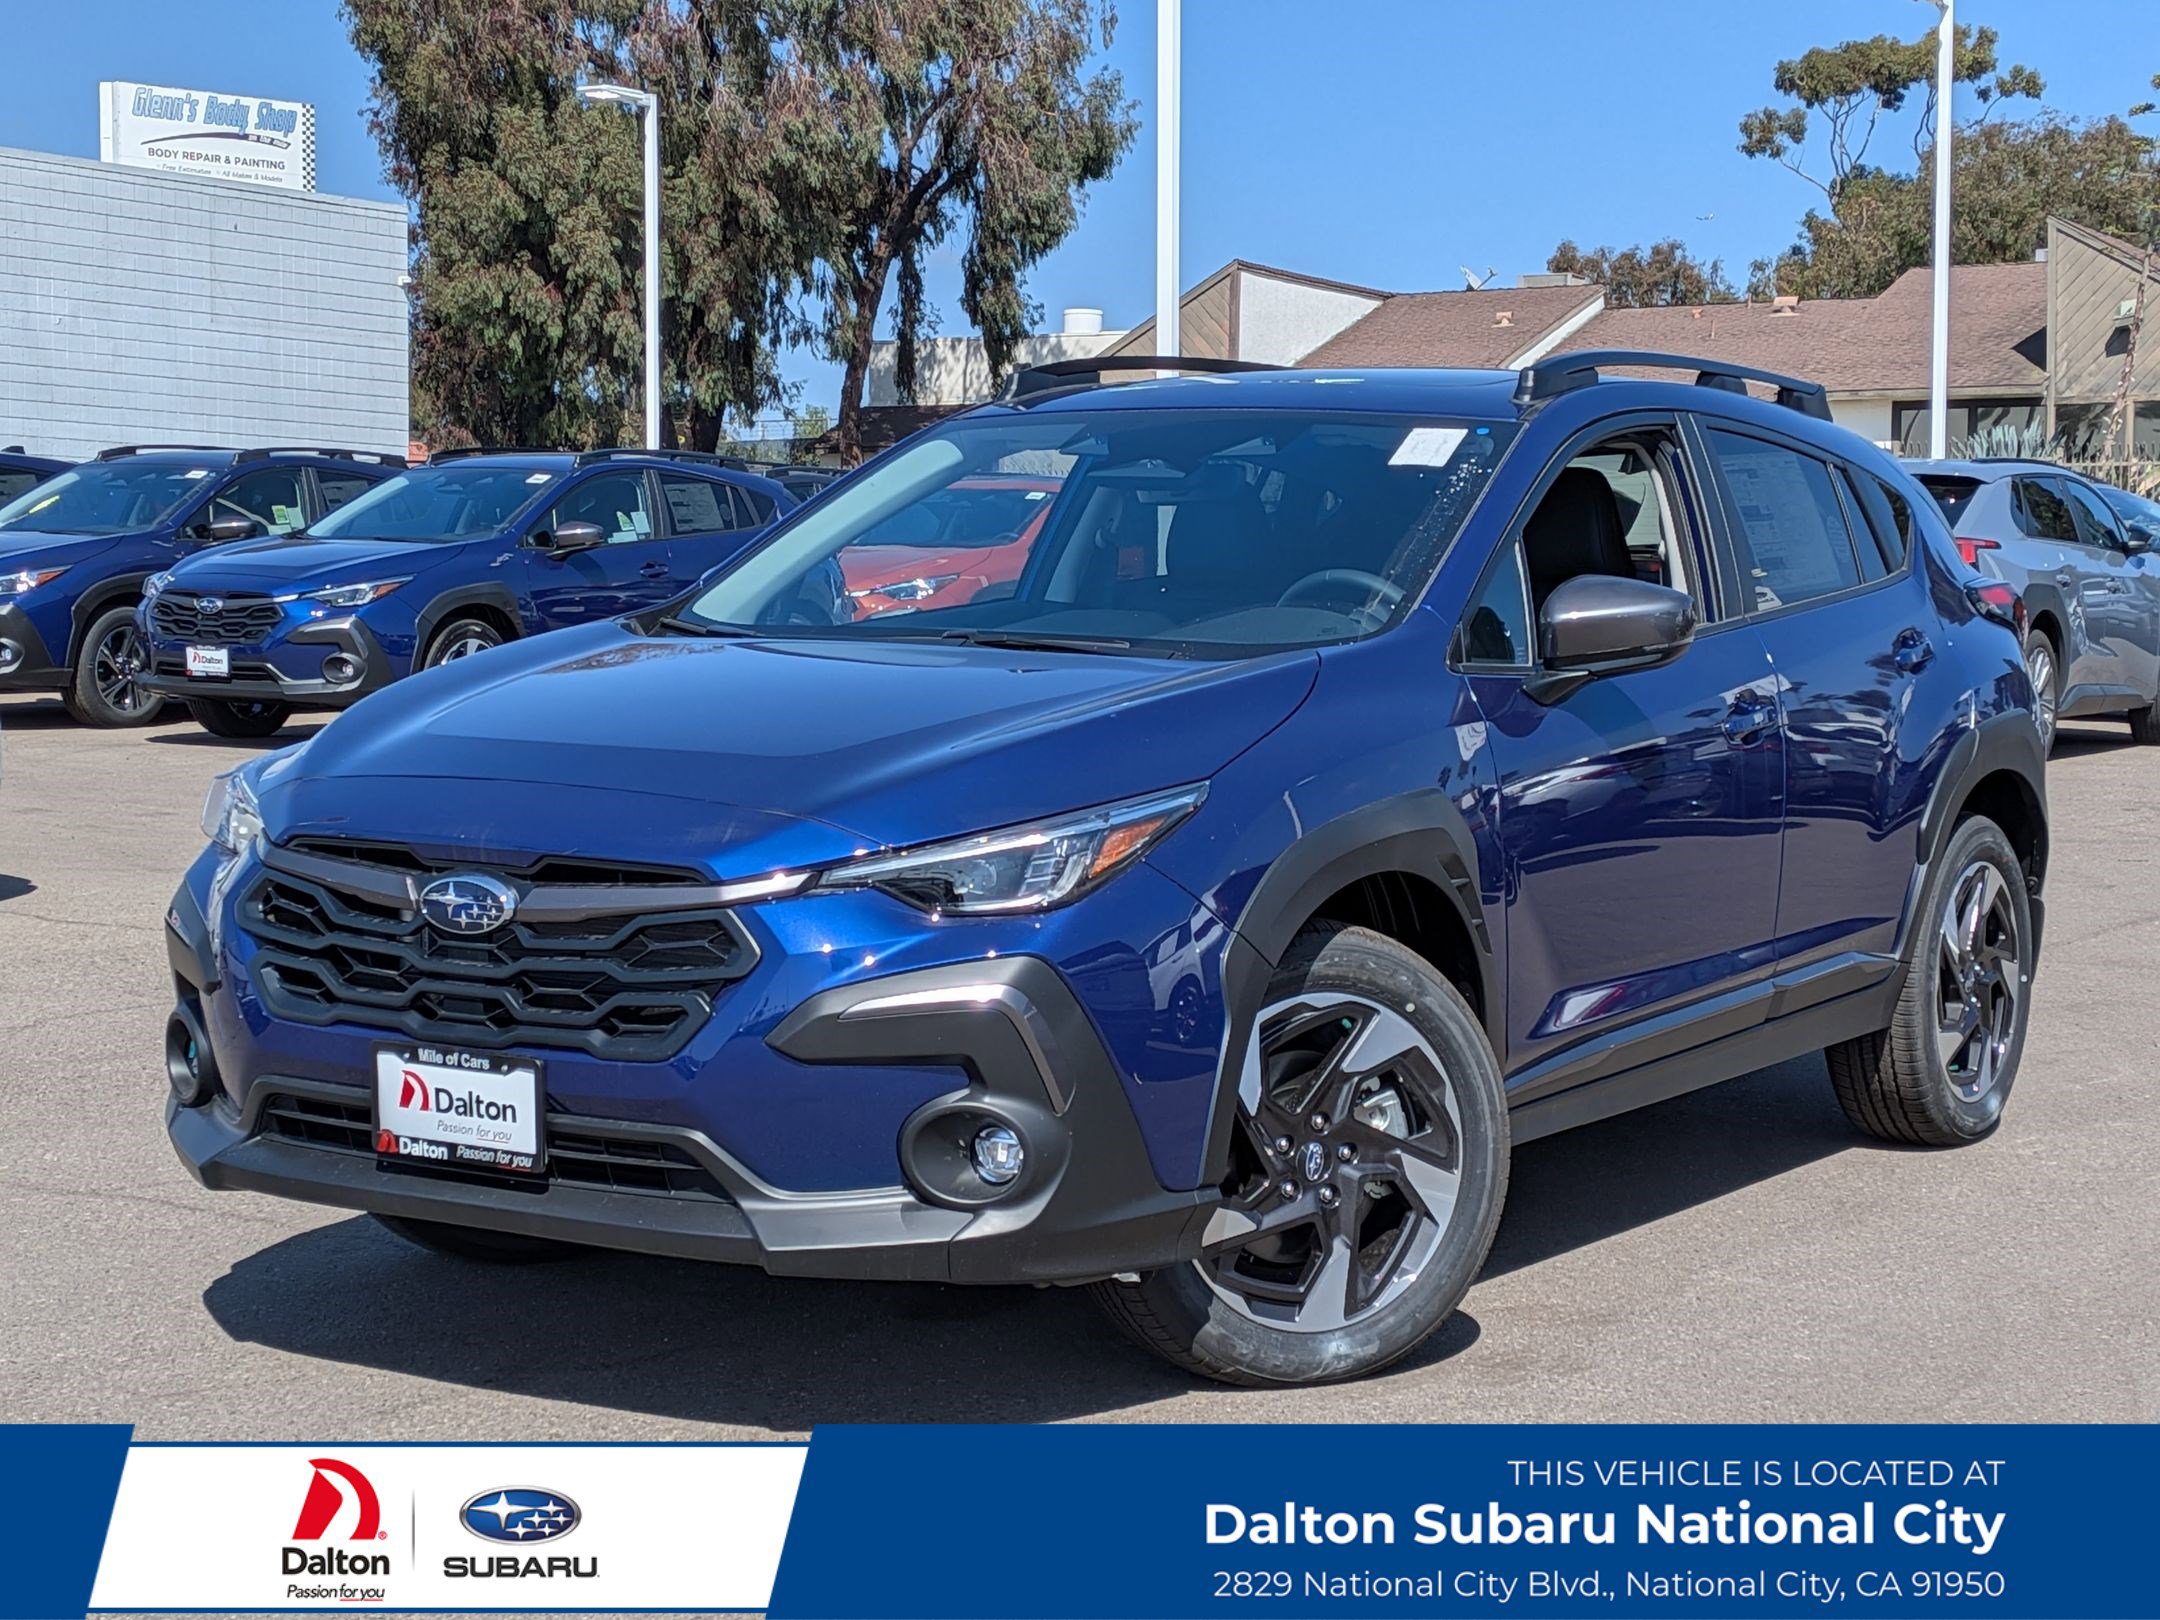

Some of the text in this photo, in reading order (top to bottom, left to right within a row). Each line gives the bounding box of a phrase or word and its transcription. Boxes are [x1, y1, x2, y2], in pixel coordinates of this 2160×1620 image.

[132, 87, 297, 137] Glenn's Body Shop
[148, 147, 285, 170] BODY REPAIR & PAINTING
[418, 1048, 490, 1070] Mile of Cars
[434, 1087, 517, 1123] Dalton
[437, 1120, 512, 1141] Passion for you
[399, 1137, 533, 1168] Dalton Passion for you
